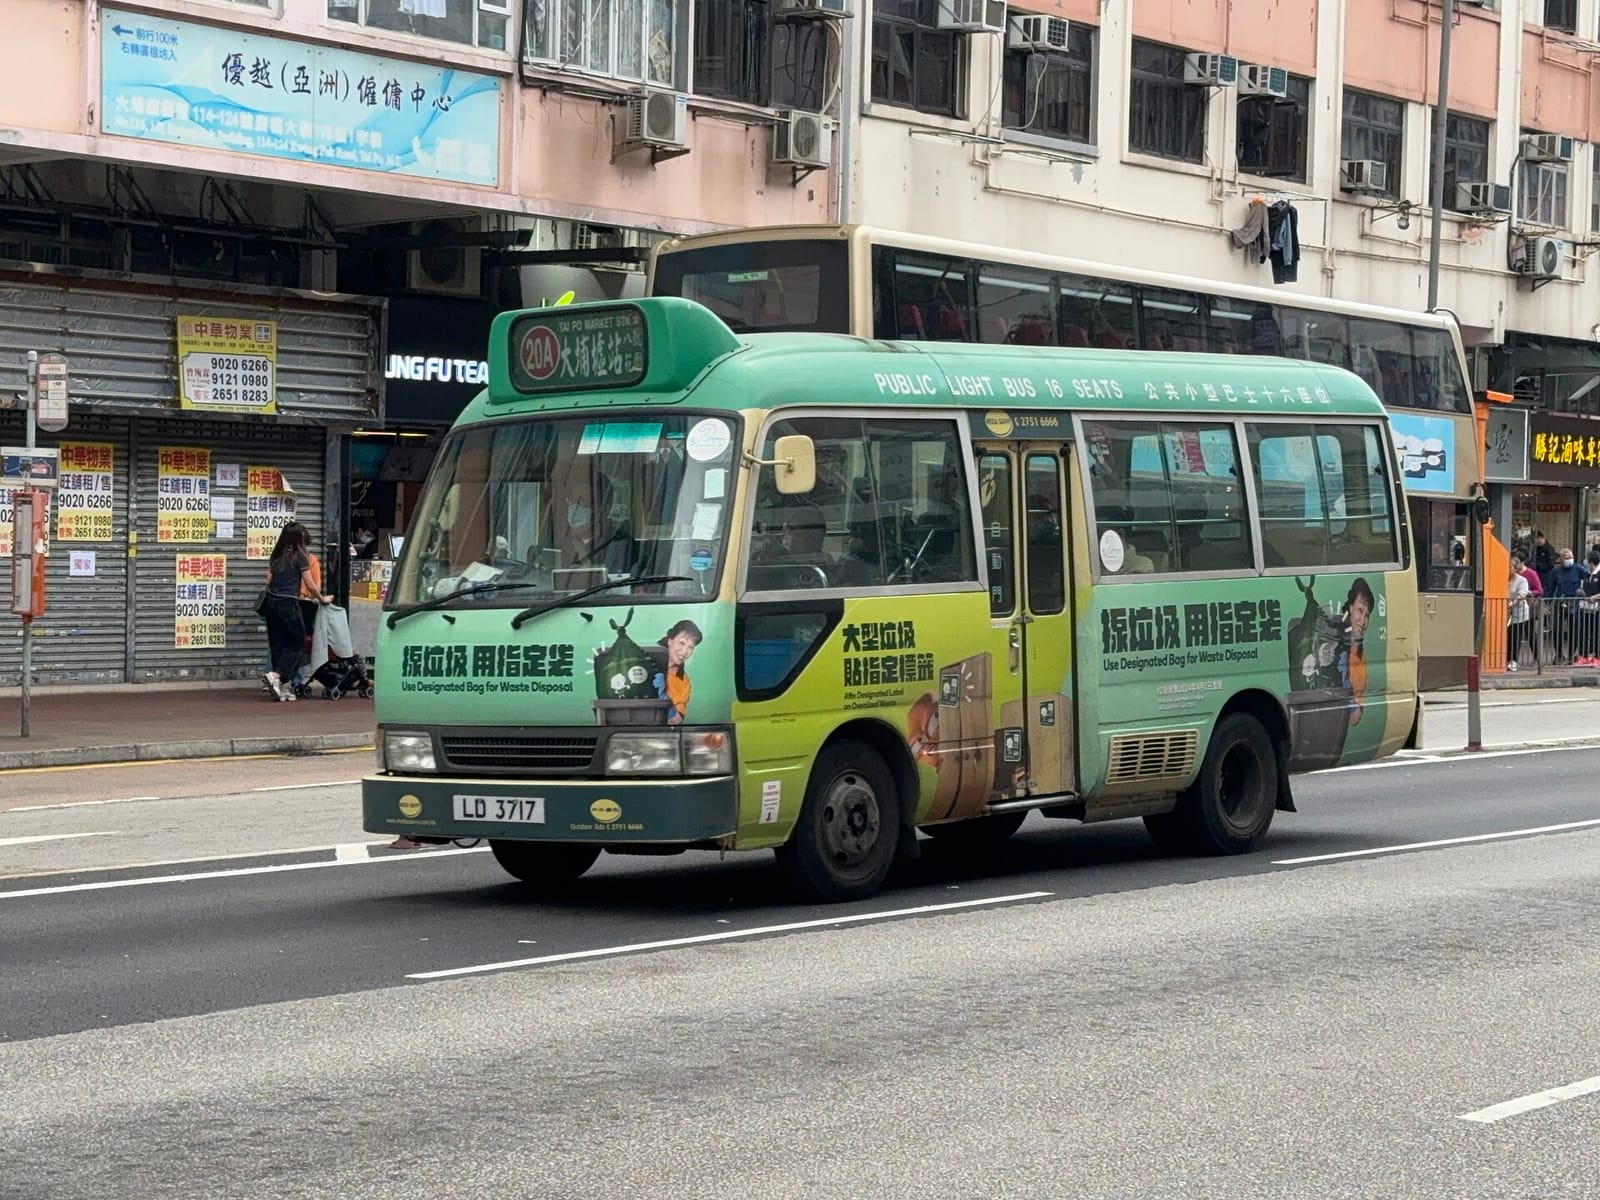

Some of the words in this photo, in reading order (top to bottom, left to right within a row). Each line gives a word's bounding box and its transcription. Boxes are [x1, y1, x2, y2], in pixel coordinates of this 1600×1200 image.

[136, 28, 178, 45] 前行100米
[194, 321, 252, 341] 中華物業
[572, 321, 582, 331] PO
[584, 317, 613, 330] MARKET
[526, 335, 554, 371] 20A
[211, 357, 238, 370] 9020
[241, 359, 268, 372] 6266
[453, 359, 489, 384] TEA
[211, 373, 238, 385] 9121
[241, 374, 268, 387] 0980
[874, 373, 936, 395] PUBLIC
[949, 375, 994, 396] LIGHT
[1002, 377, 1036, 398] BUS
[1045, 379, 1063, 398] 16
[1072, 379, 1123, 399] SEATS
[212, 388, 238, 401] 2651
[242, 389, 268, 402] 8283
[1144, 381, 1331, 404] 公共小型巴士十六座位
[1020, 416, 1039, 427] 2751
[1040, 416, 1059, 427] 6666
[61, 446, 112, 469] 中華物業
[161, 450, 208, 473] 中華物業
[250, 469, 282, 492] 中華物
[59, 494, 84, 508] 9020
[87, 495, 112, 508] 6266
[159, 497, 183, 511] 9020
[186, 498, 209, 511] 6266
[75, 515, 92, 525] 9121
[94, 516, 111, 526] 0980
[173, 518, 190, 528] 9121
[192, 518, 209, 528] 0980
[247, 516, 271, 529] 9020
[74, 527, 91, 538] 2651
[93, 528, 111, 538] 8283
[173, 530, 190, 540] 2651
[191, 529, 208, 540] 8283
[178, 557, 224, 578] 中華物業
[176, 604, 199, 617] 9020
[202, 604, 225, 617] 6266
[190, 624, 207, 633] 9121
[208, 624, 225, 633] 0980
[1184, 599, 1282, 648] 用指定袋
[191, 635, 207, 645] 2651
[208, 635, 225, 645] 8283
[842, 620, 915, 653] 大型垃圾
[472, 644, 574, 677] 用指定袋
[1103, 658, 1120, 671] Use
[1120, 655, 1168, 672] Designated
[1169, 653, 1185, 668] Bag
[1187, 651, 1198, 663] for
[1199, 651, 1224, 663] Waste
[1225, 648, 1258, 662] Disposal
[844, 653, 934, 687] 貼指定標籤
[402, 682, 416, 692] Use
[417, 681, 465, 695] Designated
[466, 682, 484, 695] Bag
[486, 681, 499, 692] for
[500, 682, 530, 692] Waste
[531, 681, 573, 695] Disposal
[463, 798, 486, 819] LD
[495, 799, 536, 821] 3717
